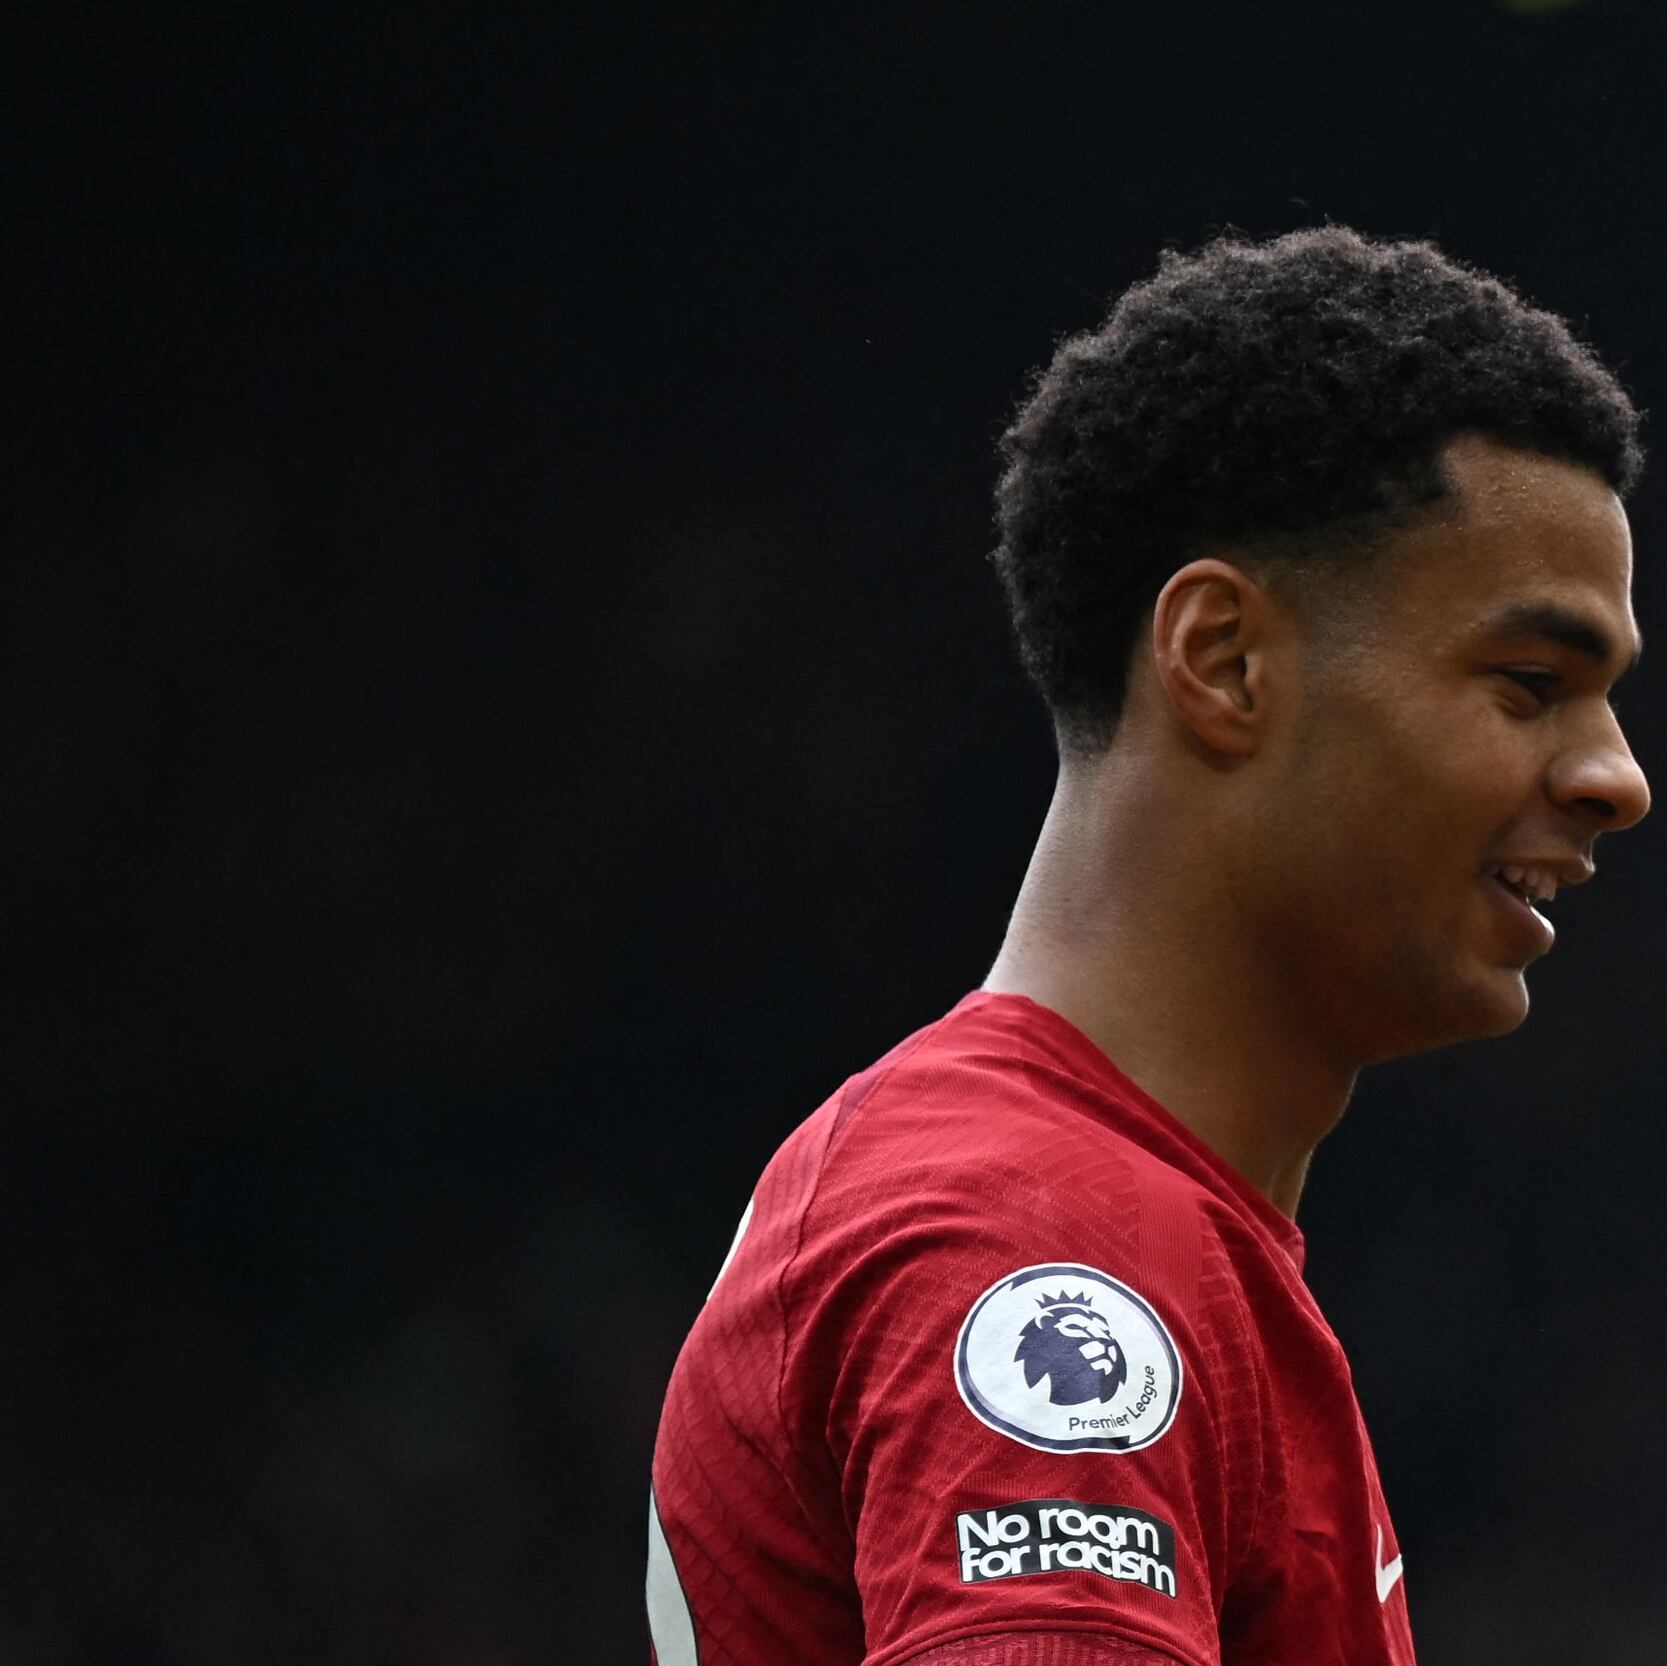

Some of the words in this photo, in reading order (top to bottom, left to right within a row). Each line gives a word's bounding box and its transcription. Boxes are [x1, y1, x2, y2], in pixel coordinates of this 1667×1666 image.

[1068, 1413, 1129, 1431] Premier
[1126, 1365, 1158, 1420] League
[957, 1510, 1030, 1547] No
[1039, 1508, 1159, 1555] room
[961, 1544, 1031, 1583] for
[1040, 1540, 1176, 1597] racism
